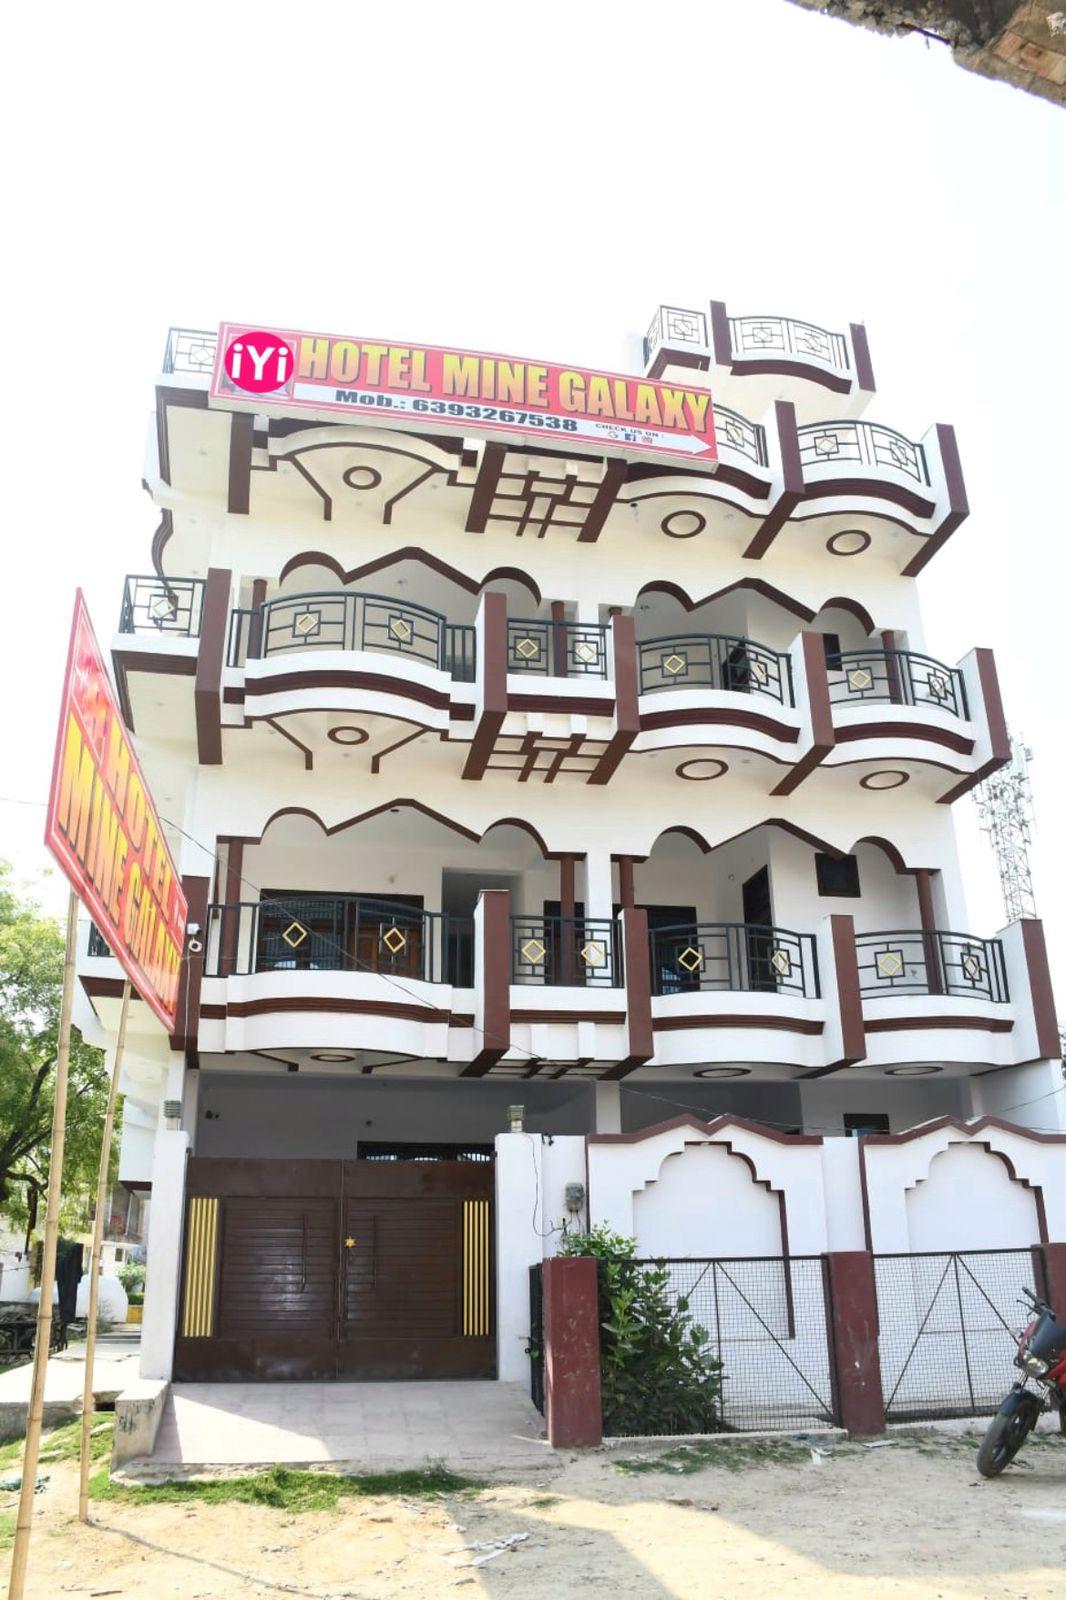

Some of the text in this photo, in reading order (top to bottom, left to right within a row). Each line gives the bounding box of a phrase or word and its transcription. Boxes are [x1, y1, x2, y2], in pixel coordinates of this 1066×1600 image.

[231, 342, 289, 382] iYi
[298, 337, 710, 433] HOTEL MINE GALAXY
[412, 398, 578, 432] 6393267538
[59, 709, 130, 929] MINE
[105, 709, 173, 928] HOTEL
